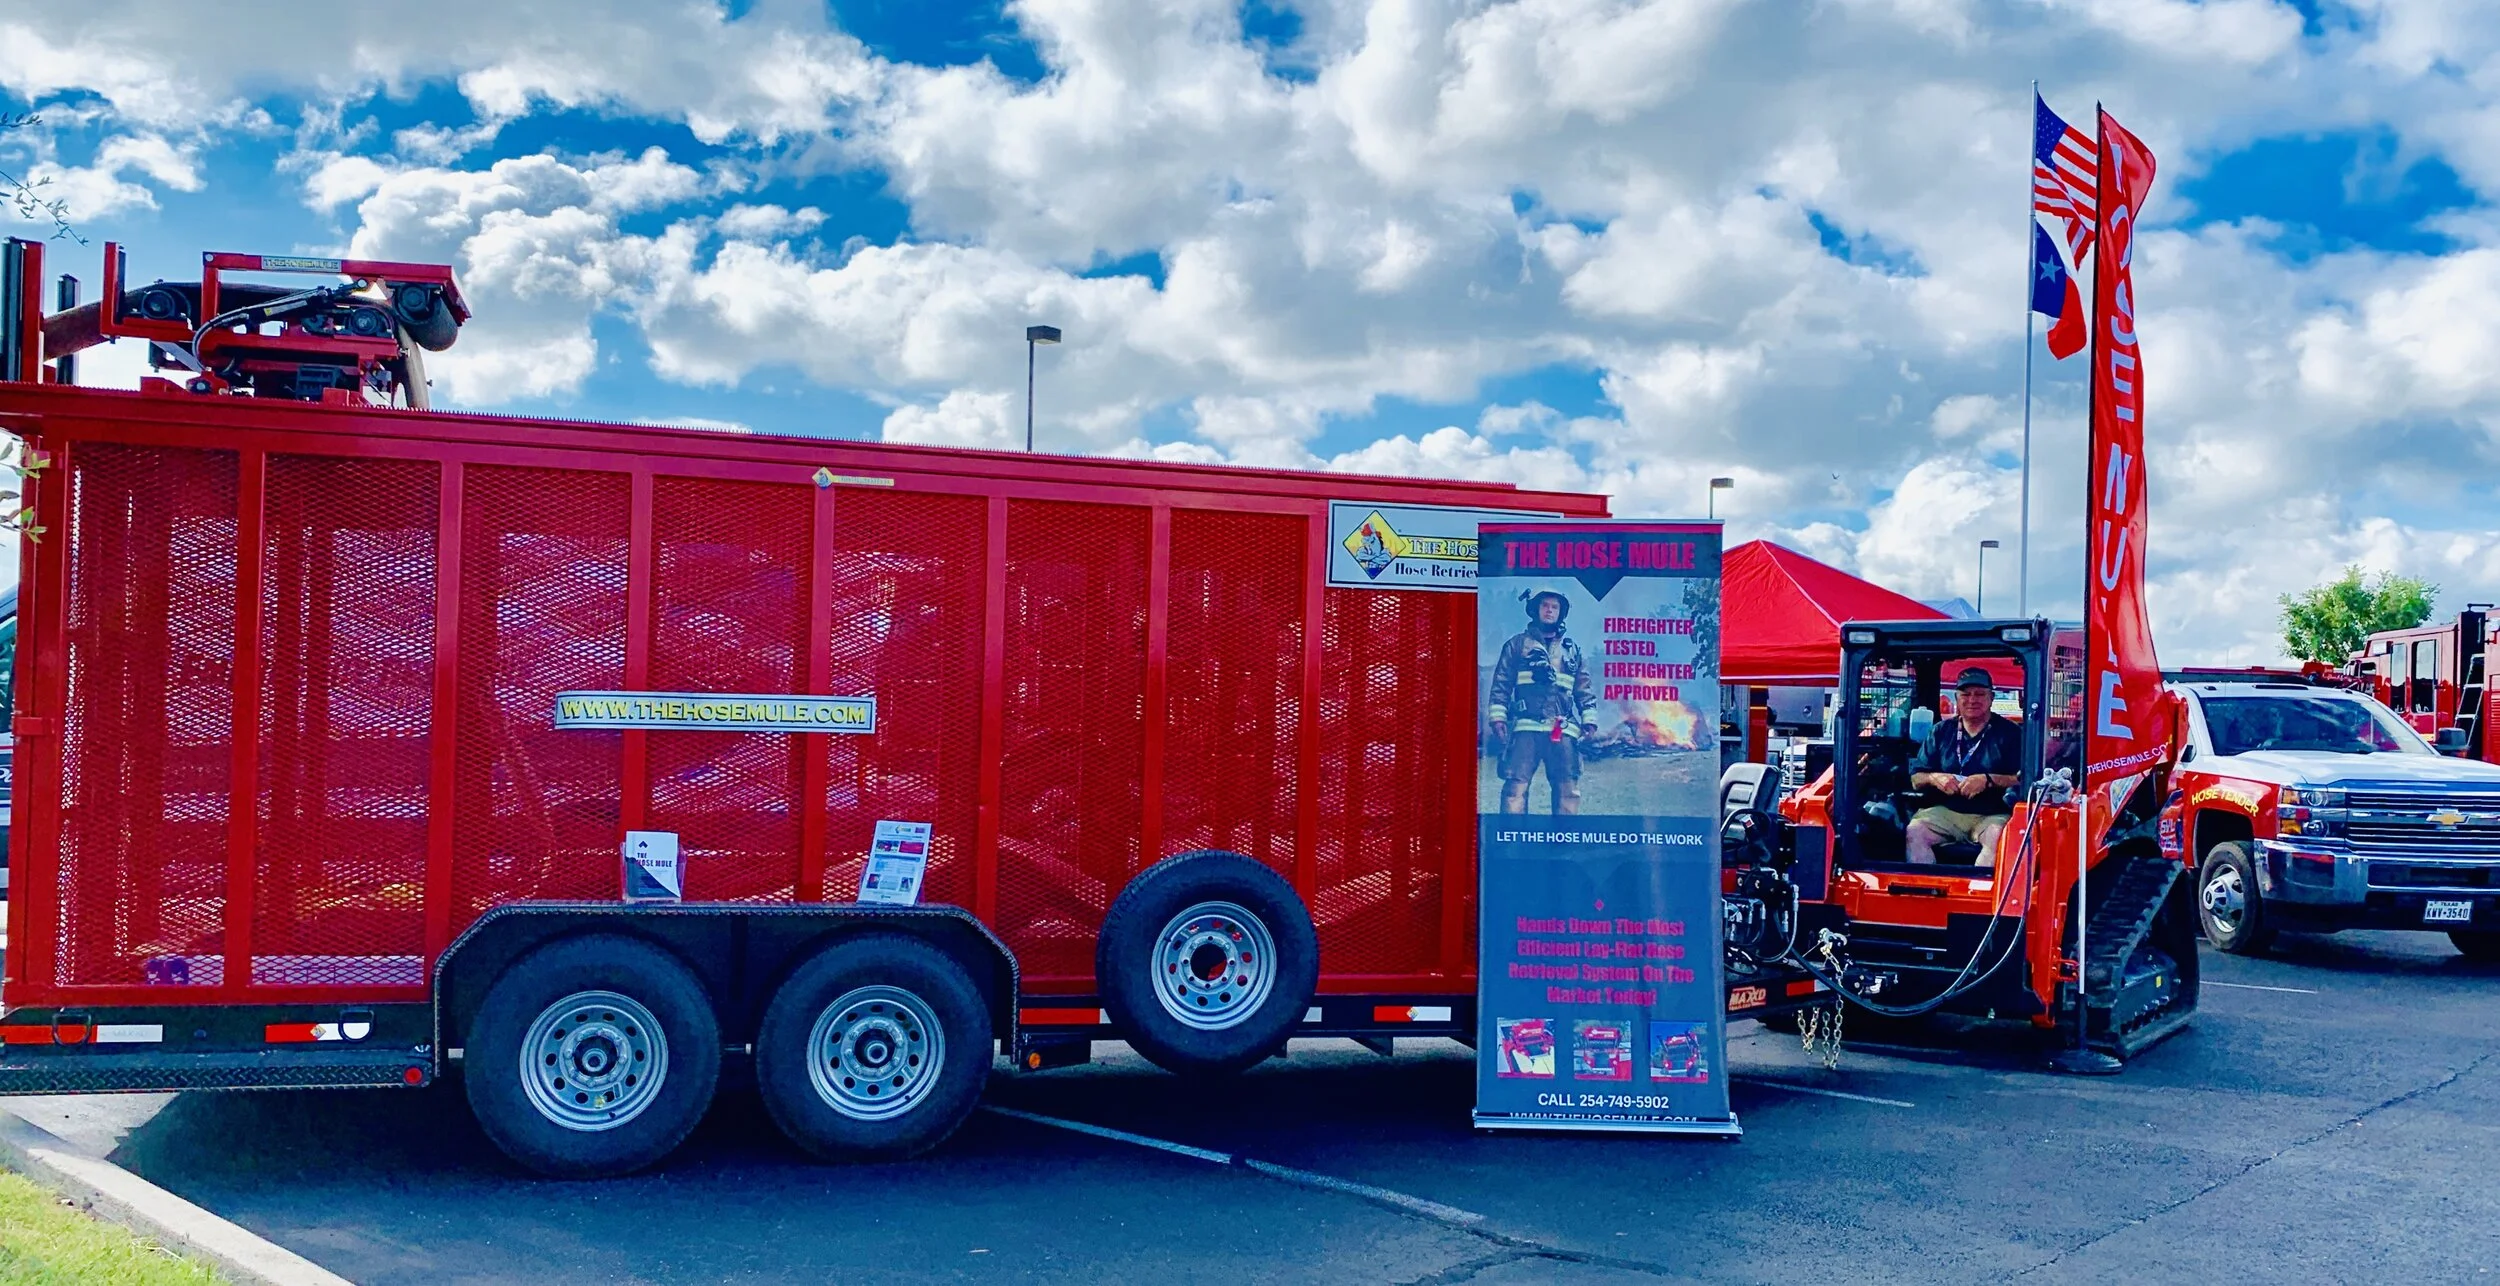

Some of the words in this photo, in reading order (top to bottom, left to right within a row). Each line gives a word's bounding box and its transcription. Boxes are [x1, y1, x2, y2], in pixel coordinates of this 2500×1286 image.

[1408, 538, 1443, 555] THE
[1445, 539, 1479, 557] HOS
[1504, 541, 1550, 569] THE
[1556, 541, 1622, 569] HOSE
[1628, 542, 1696, 570] MULE
[1395, 562, 1427, 575] Hose
[1432, 564, 1479, 578] Retriev
[1604, 617, 1694, 635] FIREFIGHTER
[1604, 640, 1659, 657] TESTED,
[1604, 662, 1694, 680] FIREFIGHTER
[1604, 684, 1679, 702] APPROVED
[561, 700, 866, 724] WWW.THEHOSEMULE.COM
[2192, 789, 2220, 805] HOSE
[2221, 789, 2259, 817] TENDER
[1496, 831, 1518, 842] LET
[1520, 831, 1544, 843] THE
[1546, 832, 1580, 843] HOSE
[1582, 832, 1617, 844] MULE
[1619, 833, 1638, 844] DO
[1640, 833, 1663, 845] THE
[1664, 834, 1703, 845] WORK
[1517, 916, 1565, 934] Hands
[1569, 917, 1611, 934] Down
[1615, 918, 1643, 935] The
[1647, 919, 1685, 936] Most
[1517, 939, 1581, 956] Efficient
[1584, 940, 1643, 959] Lay-Flat
[1646, 942, 1685, 959] Hose
[1509, 962, 1578, 979] Retrieval
[1582, 963, 1639, 982] System
[1643, 965, 1663, 982] On
[1666, 965, 1694, 983] The
[1547, 986, 1602, 1004] Market
[1604, 987, 1657, 1007] Today!
[1538, 1093, 1575, 1106] CALL
[1579, 1094, 1669, 1109] 254-749-5902
